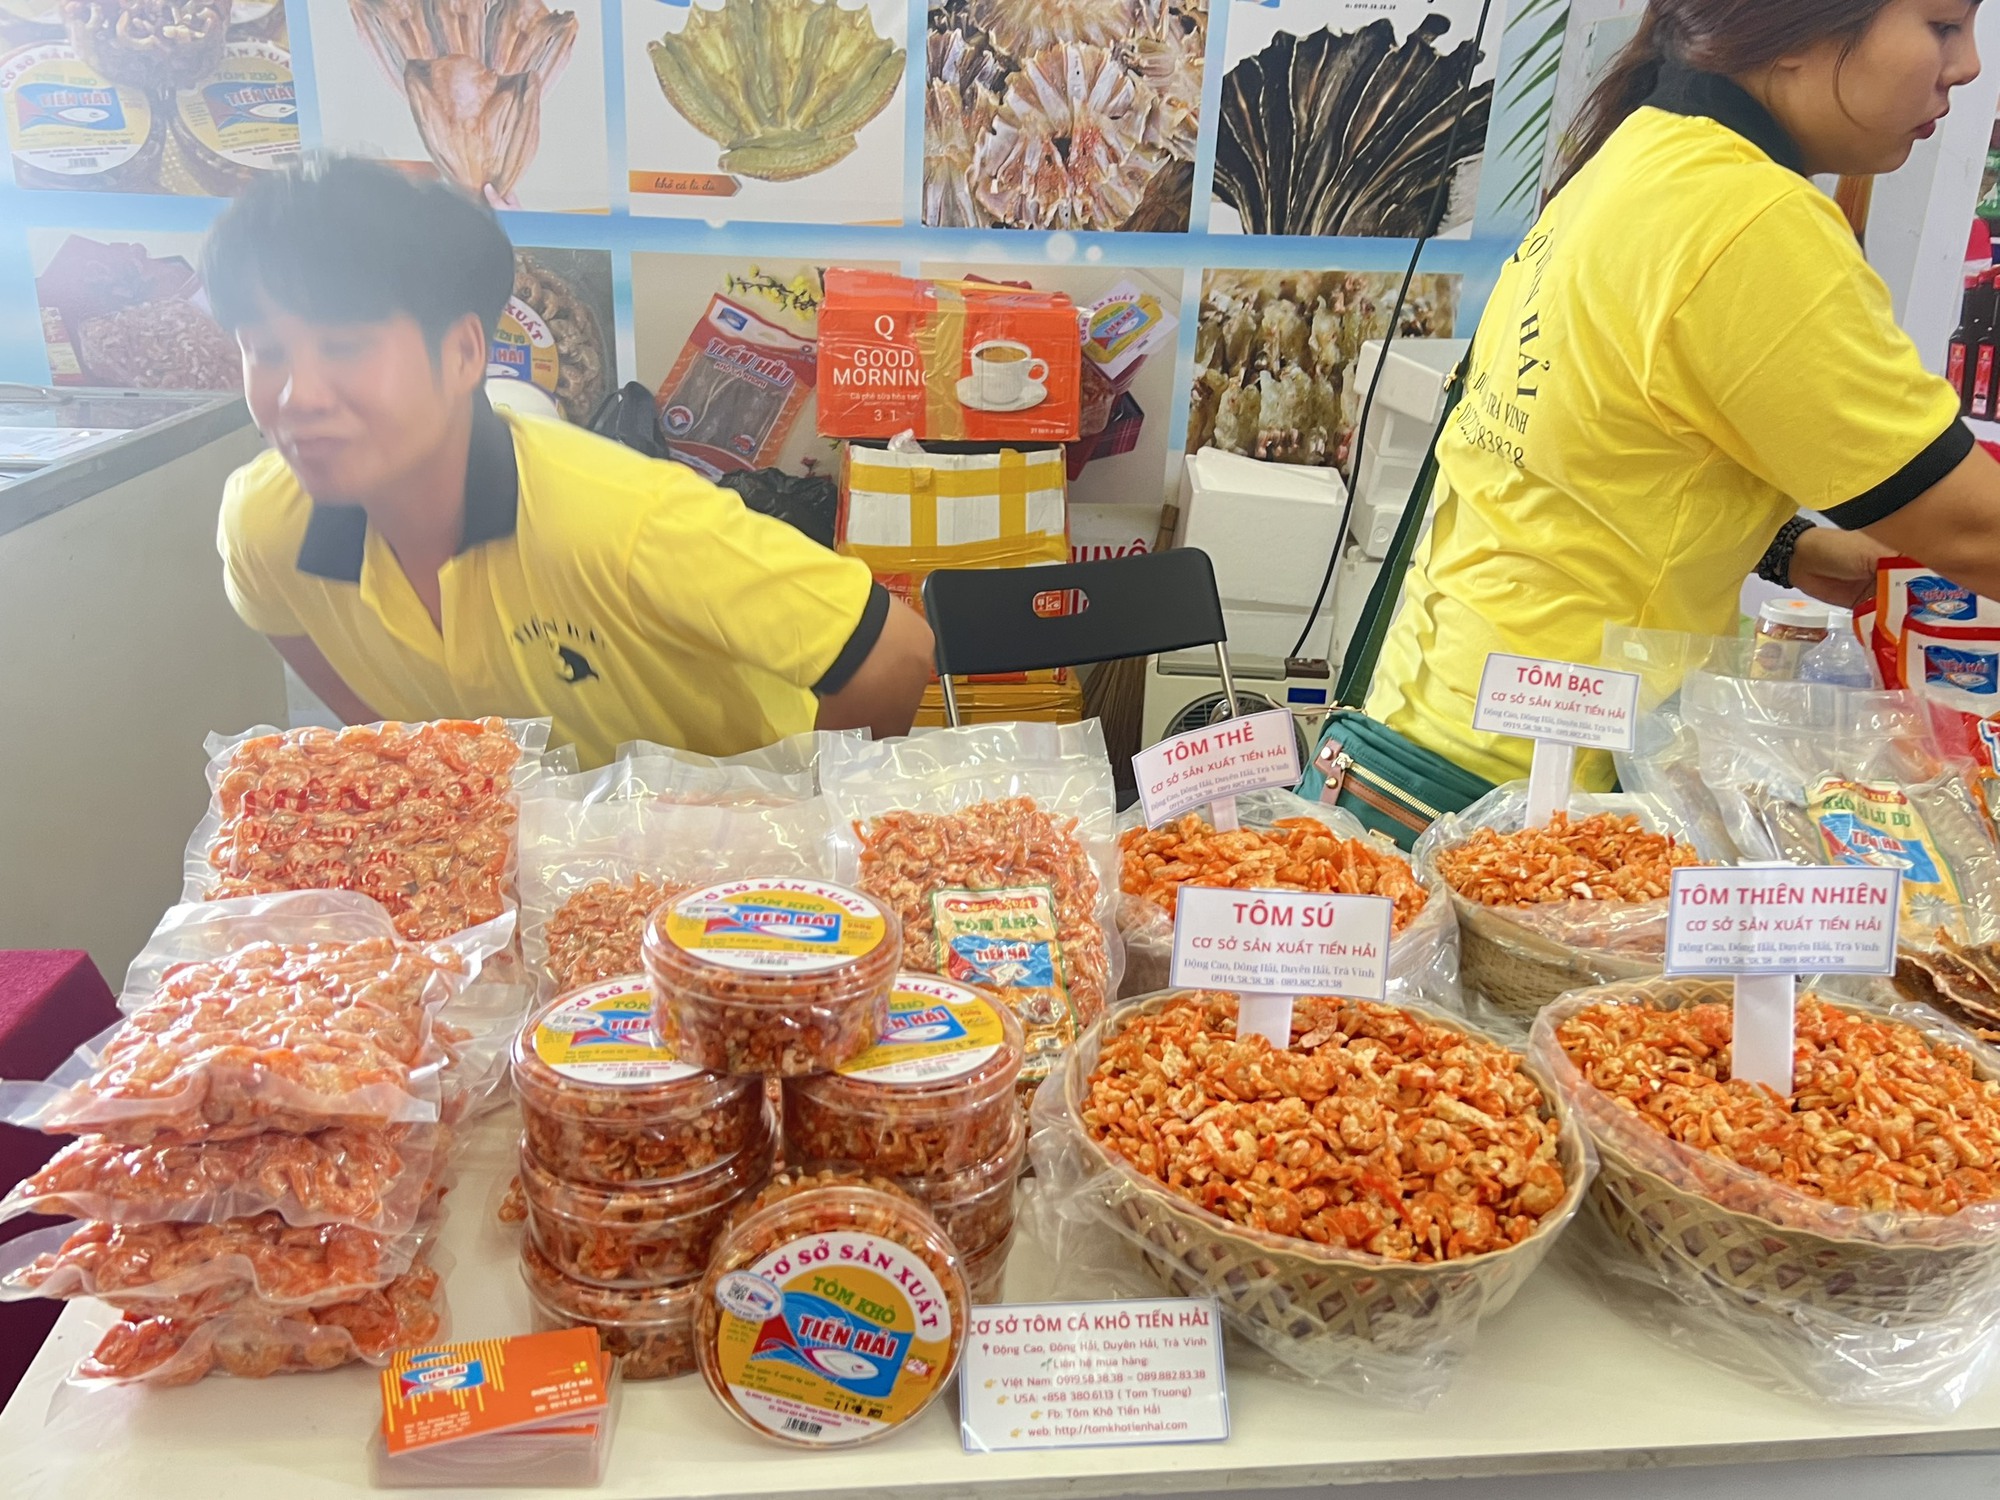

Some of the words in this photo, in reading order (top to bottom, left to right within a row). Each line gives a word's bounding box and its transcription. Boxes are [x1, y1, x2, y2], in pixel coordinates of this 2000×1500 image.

[874, 315, 895, 341] Q
[704, 337, 757, 371] TIẾN
[853, 349, 914, 368] GOOD
[1517, 664, 1562, 689] TÔM
[1567, 675, 1604, 697] BẠC
[1491, 691, 1507, 701] CƠ
[1510, 692, 1526, 704] SỞ
[1529, 695, 1550, 708] SẢN
[1554, 698, 1582, 713] XUẤT
[1584, 701, 1605, 717] TIẾN
[1608, 706, 1626, 720] HẢI
[1163, 738, 1209, 766] TÔM
[1214, 721, 1254, 749] THẺ
[1151, 781, 1163, 794] CƠ
[1166, 773, 1179, 787] SỞ
[1182, 763, 1204, 780] SẢN
[1208, 755, 1236, 772] XUẤT
[1240, 750, 1264, 762] TIẾN
[1267, 744, 1287, 757] HẢI
[742, 896, 780, 906] TÔM
[787, 898, 826, 912] KHÔ
[815, 888, 865, 913] XUẤT
[1679, 883, 1730, 905] TÔM
[1736, 882, 1805, 905] THIÊN
[1811, 882, 1887, 905] NHIÊN
[741, 910, 791, 924] TIẾN
[794, 912, 835, 927] HẢI
[1233, 898, 1293, 926] TÔM
[1301, 902, 1334, 928] SÚ
[1686, 919, 1706, 932] CƠ
[1712, 918, 1733, 932] SỞ
[1738, 918, 1769, 932] SẢN
[1773, 915, 1813, 932] XUẤT
[1818, 915, 1849, 931] TIẾN
[1855, 917, 1881, 932] HẢI
[1192, 936, 1213, 949] CƠ
[1218, 936, 1238, 950] SỞ
[1243, 937, 1271, 953] SẢN
[1276, 939, 1313, 954] XUẤT
[1319, 941, 1347, 956] TIẾN
[1352, 942, 1376, 958] HẢI
[595, 985, 624, 999] SỞ
[897, 983, 958, 1000] XUẤT
[909, 1008, 948, 1027] HẢI
[797, 1238, 831, 1266] SỞ
[839, 1240, 894, 1271] SẢN
[894, 1262, 943, 1329] XUẤT
[812, 1274, 854, 1306] TÔM
[855, 1296, 897, 1325] KHÔ
[995, 1313, 1019, 1335] SỞ
[1024, 1314, 1062, 1333] TÔM
[1067, 1310, 1089, 1332] CÁ
[1094, 1311, 1131, 1330] KHÔ
[1135, 1308, 1175, 1328] TIẾN
[1179, 1306, 1209, 1327] HẢI
[798, 1312, 850, 1346] TIẾN
[852, 1328, 899, 1361] HẢI
[992, 1343, 1020, 1357] Động
[1103, 1339, 1137, 1353] Duyên
[1163, 1337, 1180, 1348] Trà
[1183, 1336, 1207, 1347] Vinh
[1079, 1357, 1092, 1369] hệ
[1096, 1357, 1119, 1367] mua
[1002, 1376, 1024, 1389] Việt
[1126, 1387, 1148, 1399] Tom
[1152, 1386, 1192, 1400] Truong)
[1047, 1408, 1063, 1420] Fb:
[1066, 1406, 1090, 1418] Tôm
[1093, 1405, 1114, 1417] Khô
[1117, 1404, 1140, 1416] Tiến
[1144, 1403, 1161, 1416] Hải
[1054, 1419, 1188, 1437] http://tomkhotienhai.com
